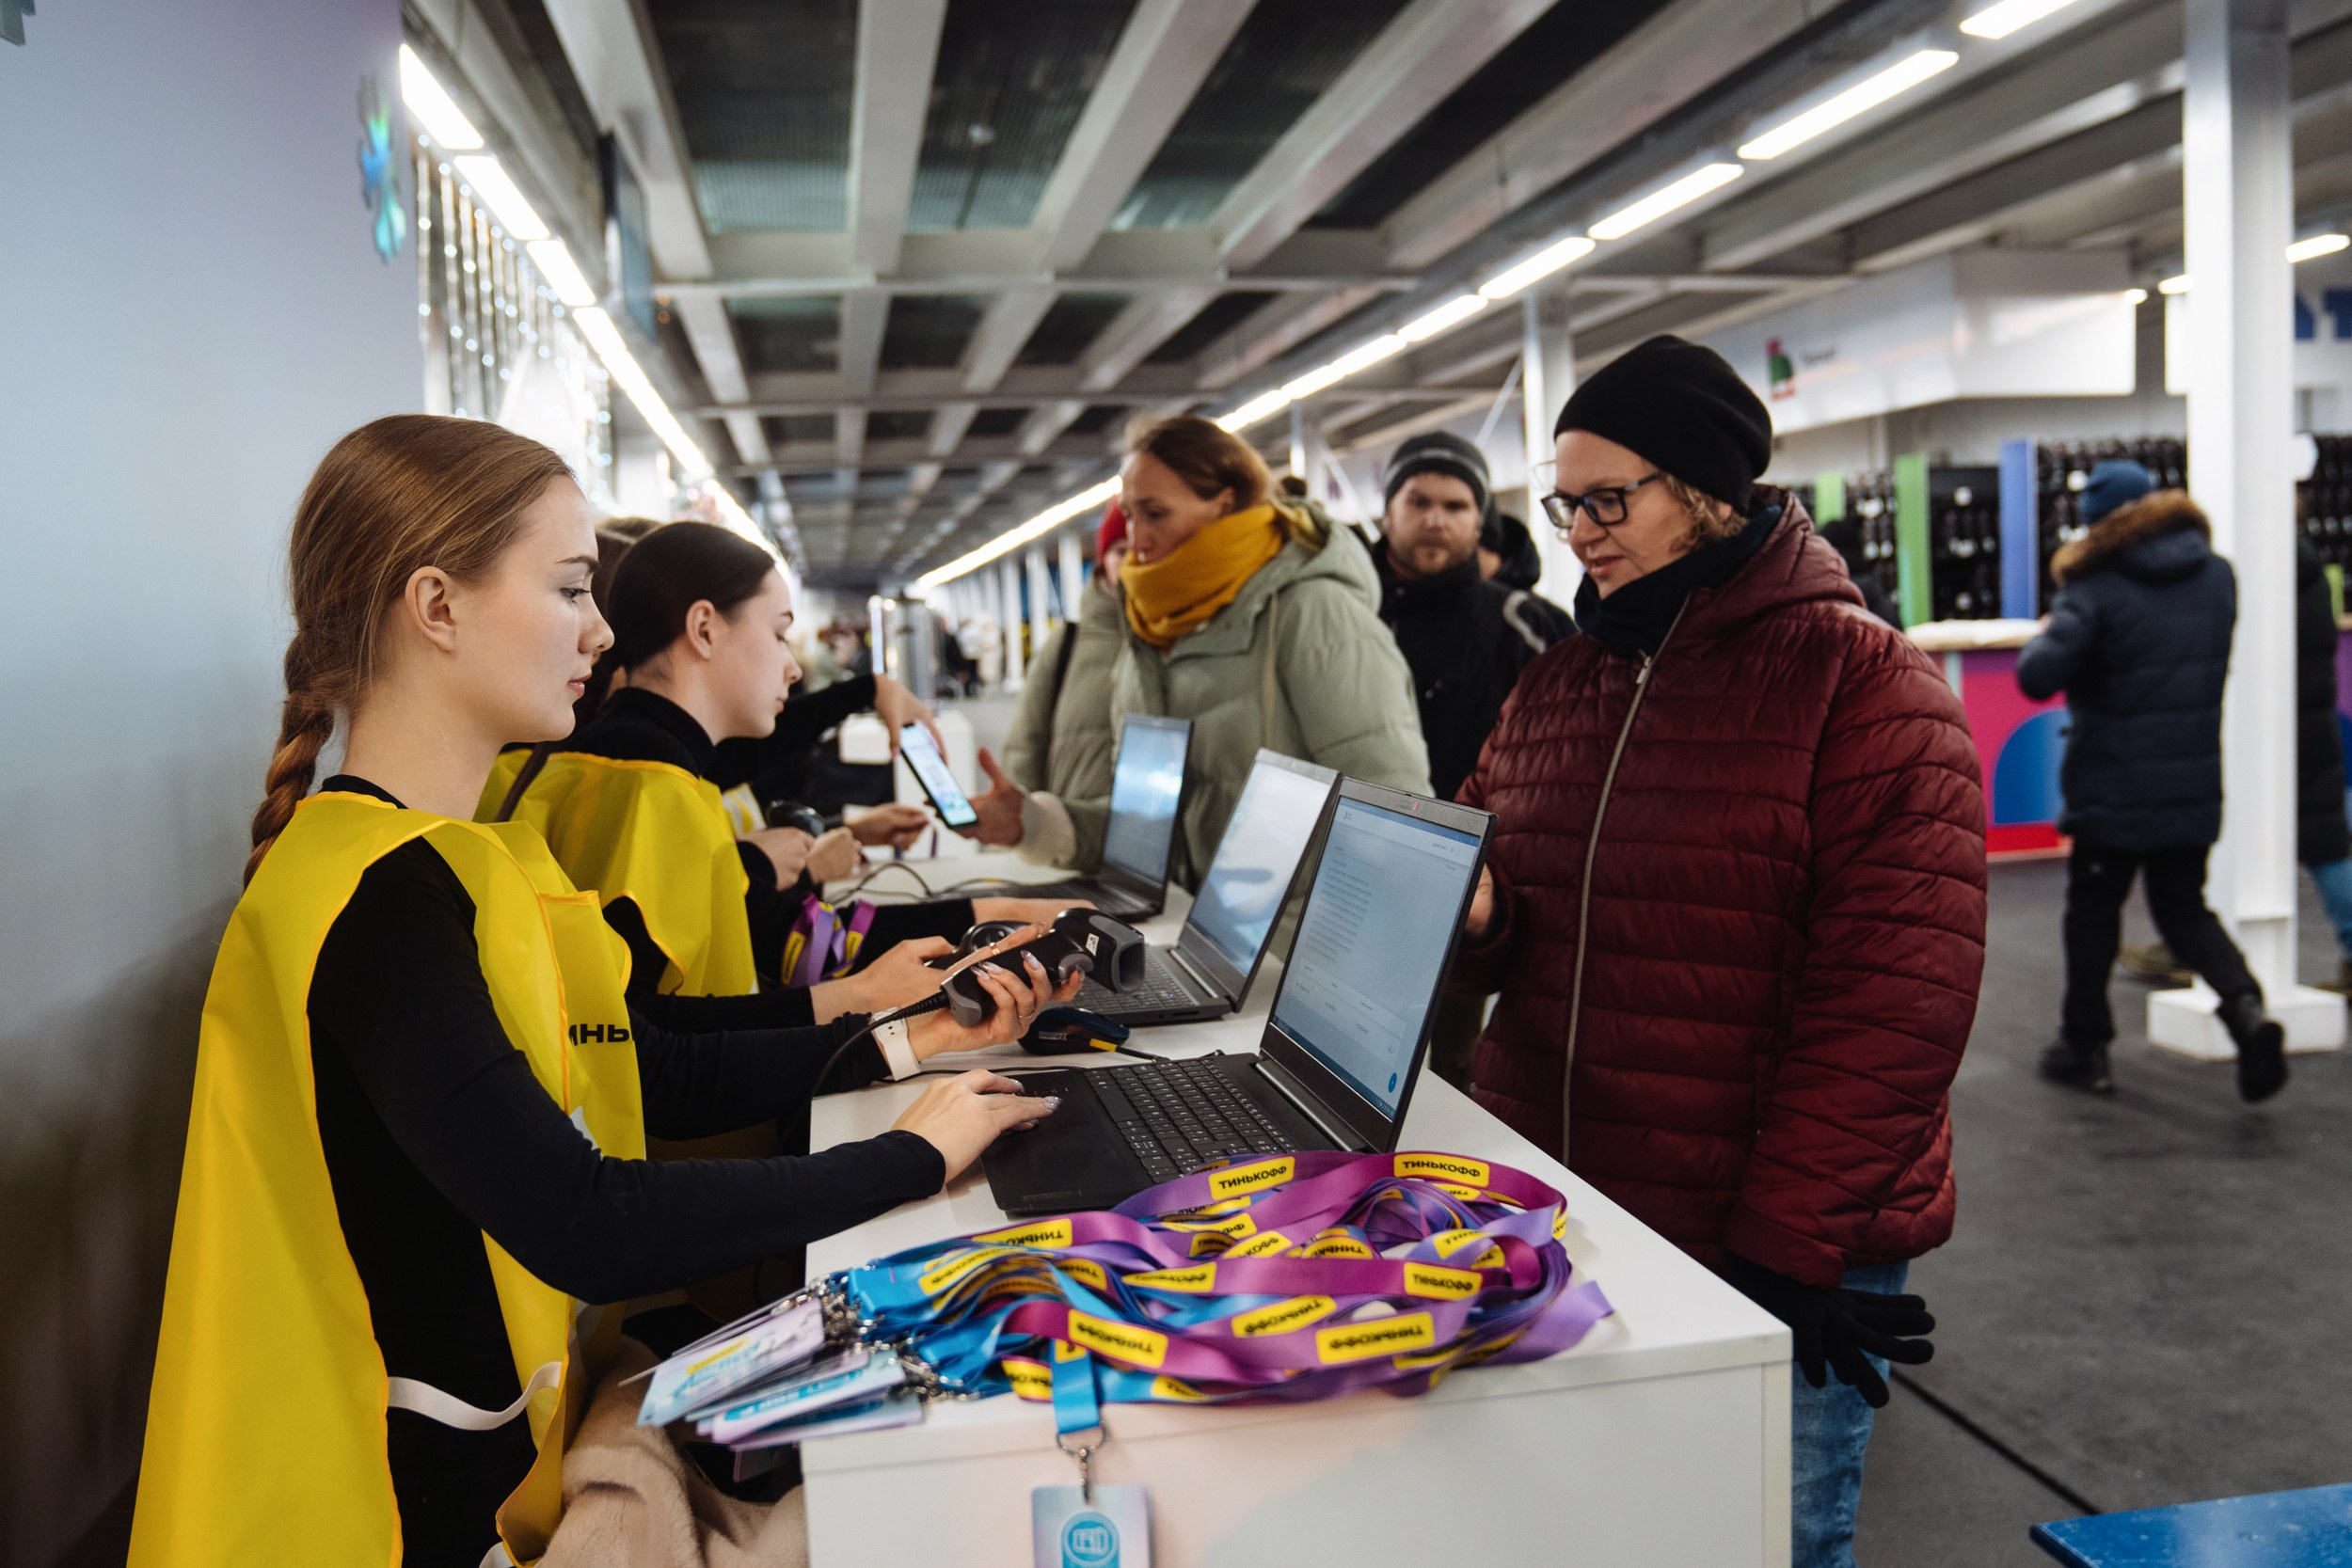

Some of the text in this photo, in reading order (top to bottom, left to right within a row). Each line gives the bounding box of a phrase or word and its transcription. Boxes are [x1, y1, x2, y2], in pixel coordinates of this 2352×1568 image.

[1218, 1165, 1287, 1189] ТИНЬКОФФ
[1403, 1160, 1480, 1178] ТИНЬКОФФ
[1412, 1273, 1473, 1291] ТИНЬКОФФ
[1245, 1299, 1322, 1334] ТИНЬКОФФ
[1329, 1324, 1424, 1350] ТИНЬКОФФ
